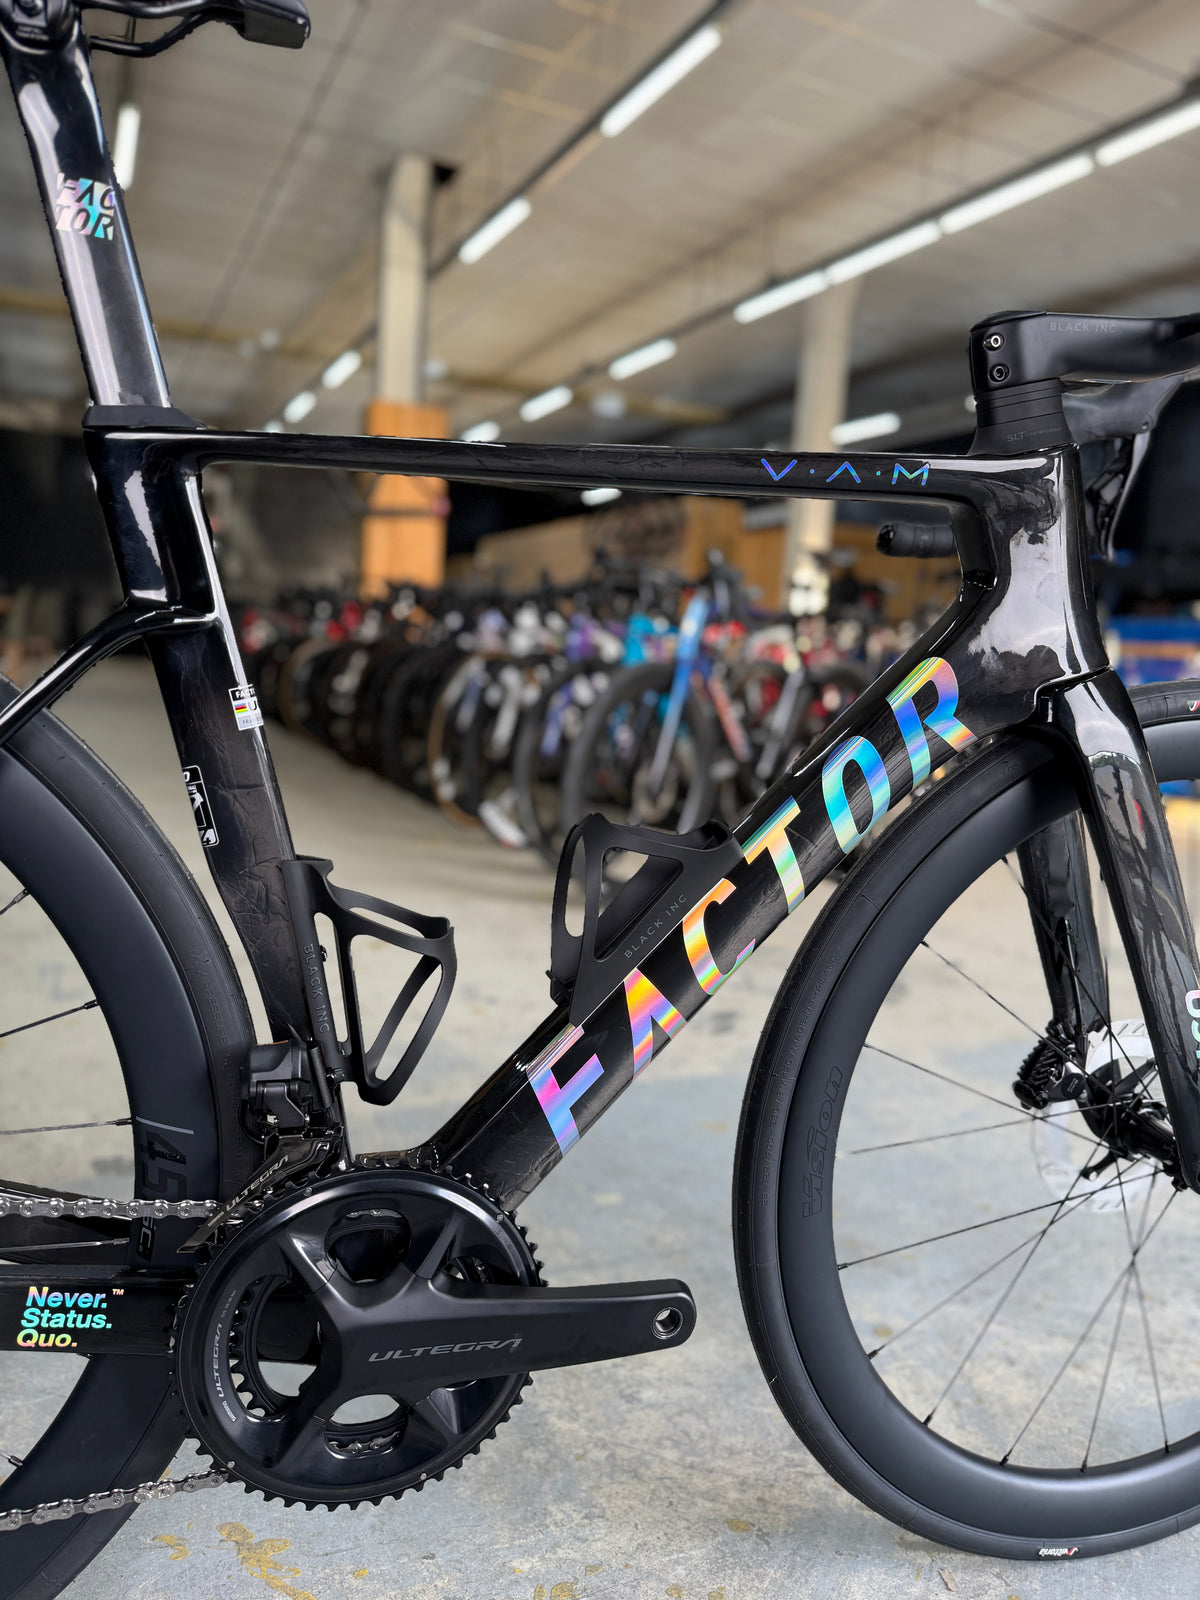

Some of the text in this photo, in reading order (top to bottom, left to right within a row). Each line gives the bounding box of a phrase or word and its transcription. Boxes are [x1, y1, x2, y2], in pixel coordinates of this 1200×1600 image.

[1049, 321, 1117, 334] BLACK INC
[525, 656, 978, 1160] FACTOR
[624, 894, 687, 959] BLACK INC
[303, 943, 330, 1033] BLACK INC
[802, 1065, 844, 1219] Vision
[226, 1154, 289, 1212] ULTEGRA
[20, 1307, 113, 1329] Status.
[25, 1285, 108, 1309] Never.
[16, 1328, 78, 1348] Quo.
[212, 1322, 224, 1398] ULTEGRA
[368, 1338, 523, 1362] ULTEGRA
